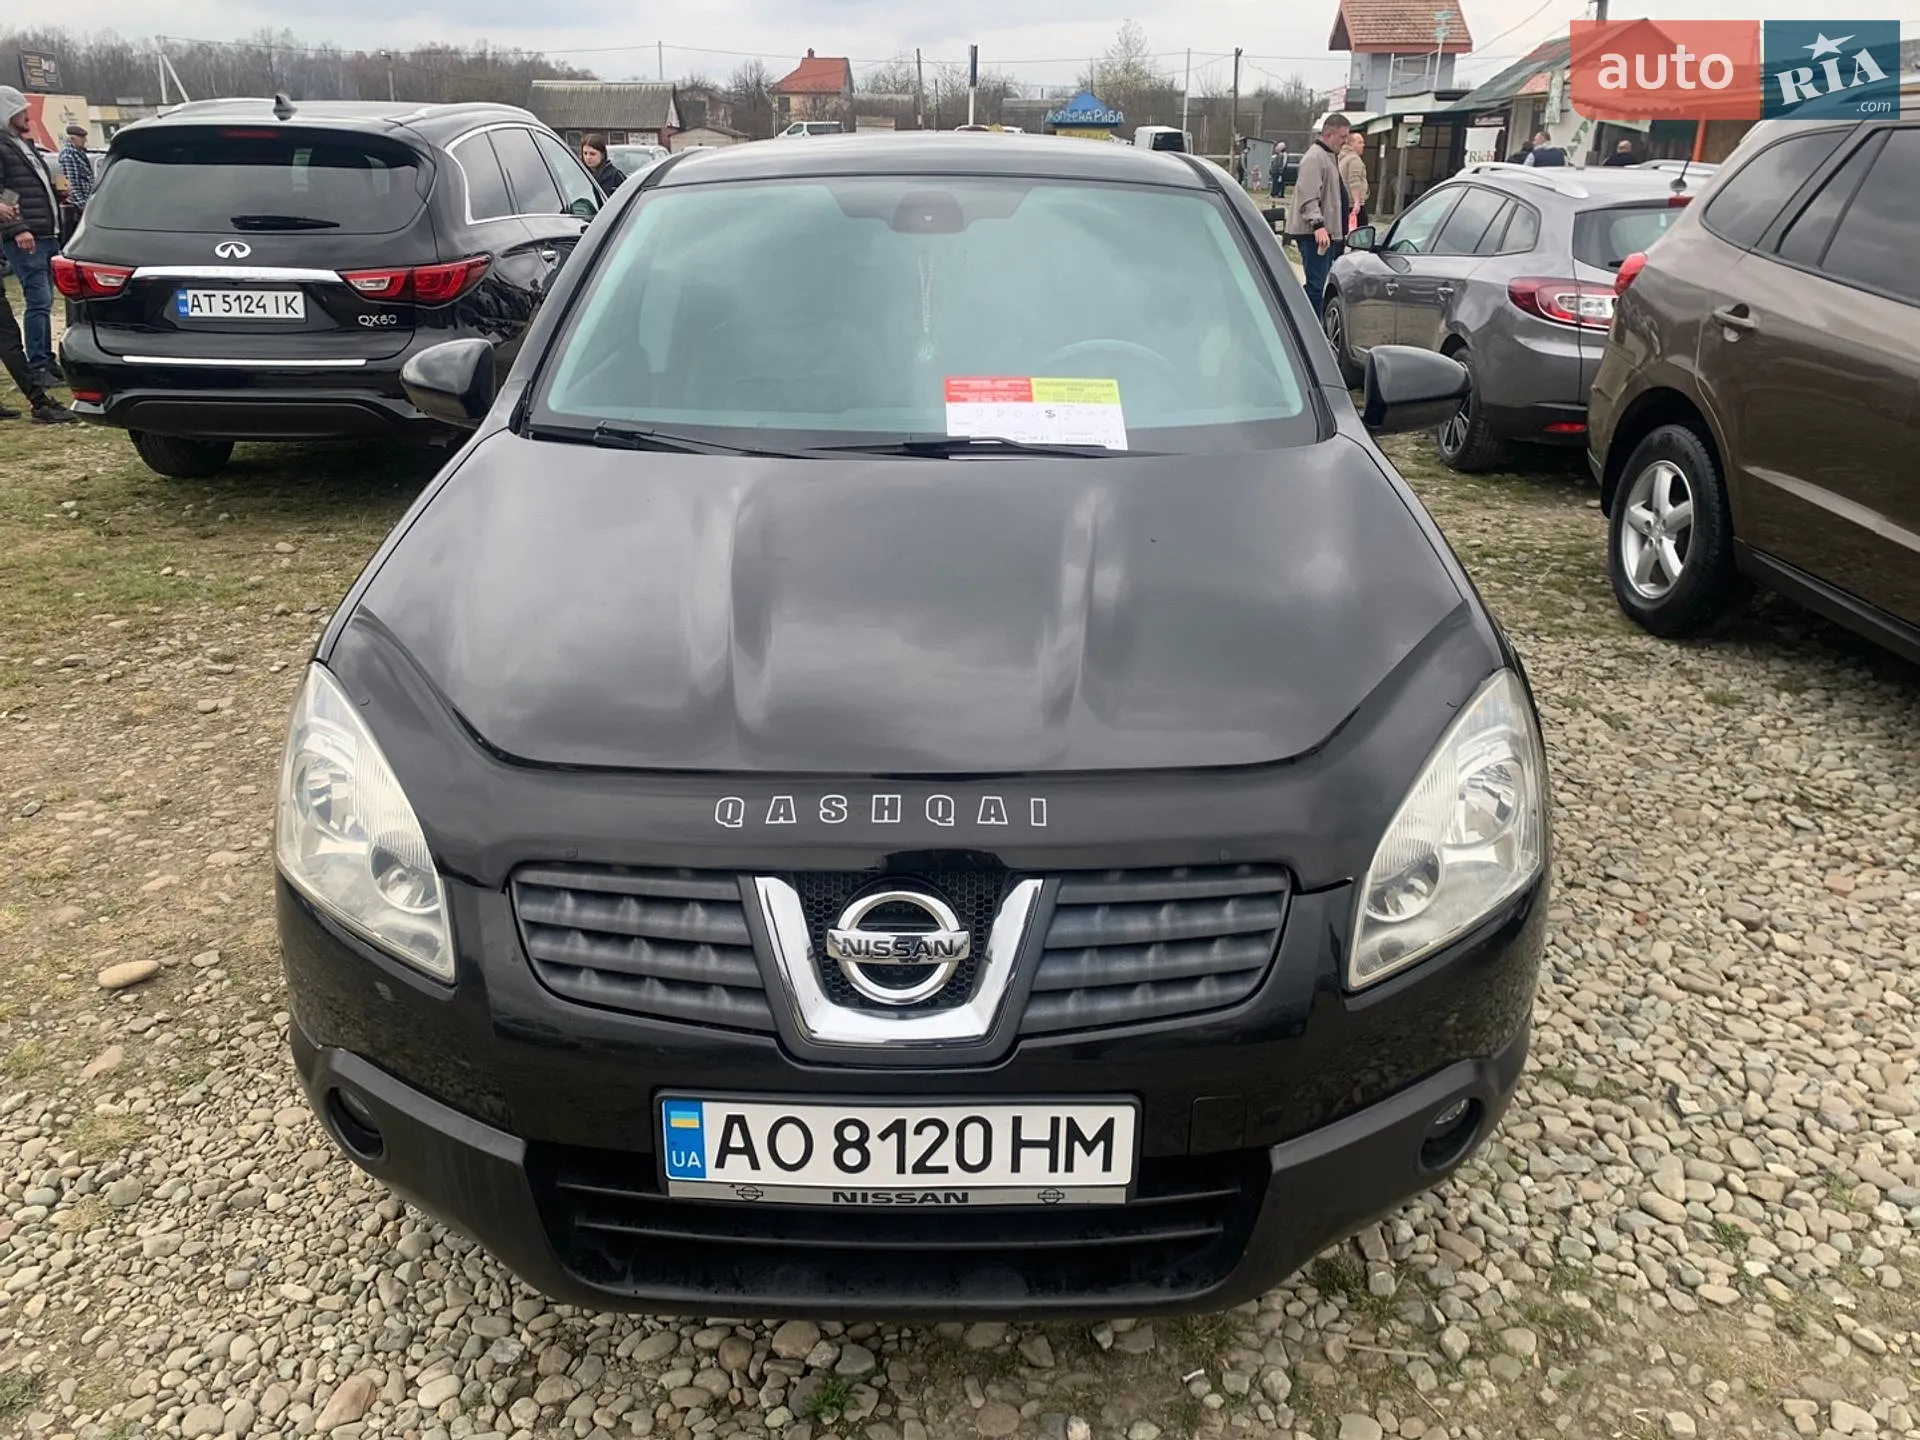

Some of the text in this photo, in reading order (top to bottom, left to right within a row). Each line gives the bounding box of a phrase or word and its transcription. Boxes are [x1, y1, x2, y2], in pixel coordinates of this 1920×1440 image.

[191, 294, 216, 312] AT
[222, 294, 267, 313] 5124
[275, 296, 299, 314] IK
[358, 314, 397, 326] QX60
[715, 794, 1047, 827] QASHQAI
[842, 938, 954, 958] NISSAN
[672, 1113, 1115, 1174] UA AO 8120 HM
[832, 1191, 969, 1205] NISSAN
